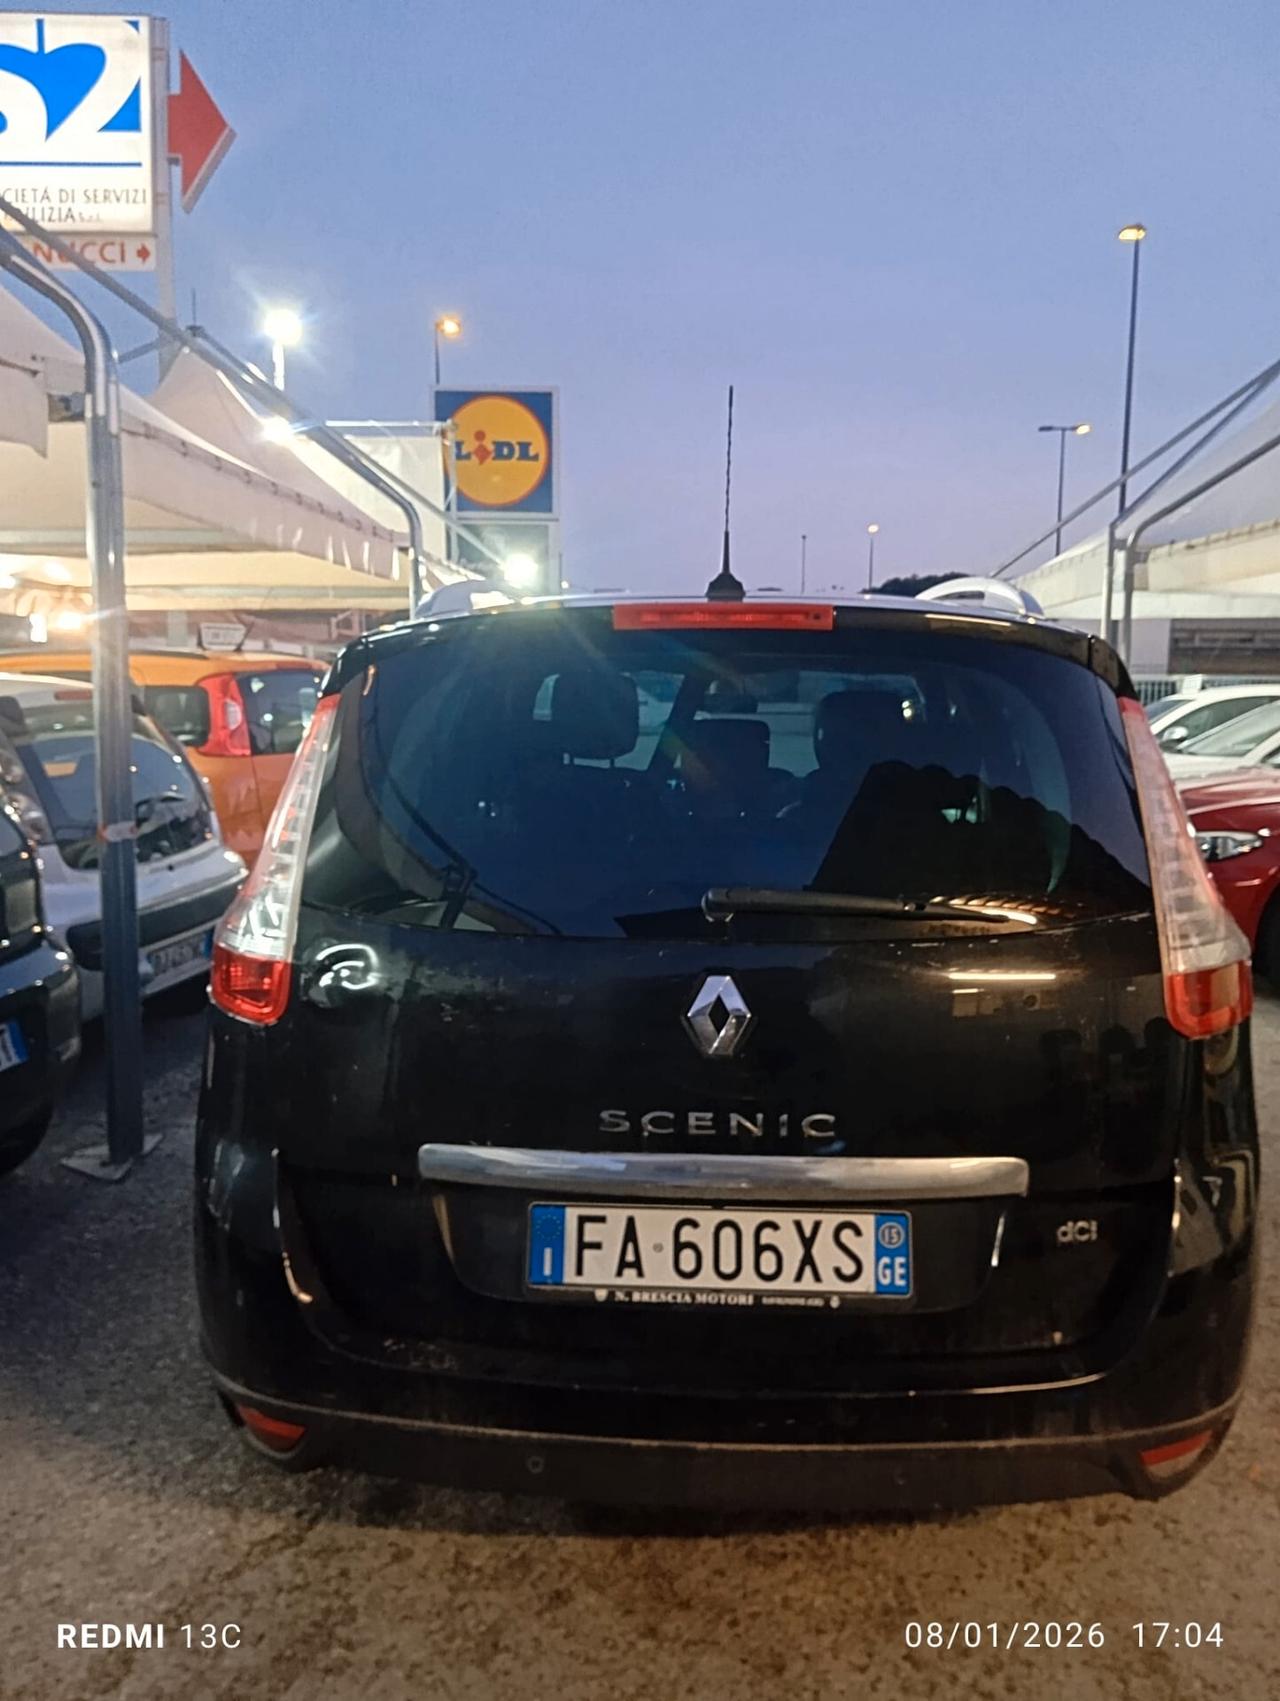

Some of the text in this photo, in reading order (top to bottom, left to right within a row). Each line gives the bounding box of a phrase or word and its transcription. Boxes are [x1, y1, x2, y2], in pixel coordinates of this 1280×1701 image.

[59, 189, 75, 204] DI
[83, 188, 147, 204] SERVIZI
[599, 1109, 837, 1137] SCENIC
[575, 1214, 864, 1283] FA 606XS
[878, 1255, 907, 1287] GE
[632, 1290, 693, 1305] BRESCIA
[694, 1292, 755, 1307] MOTORI
